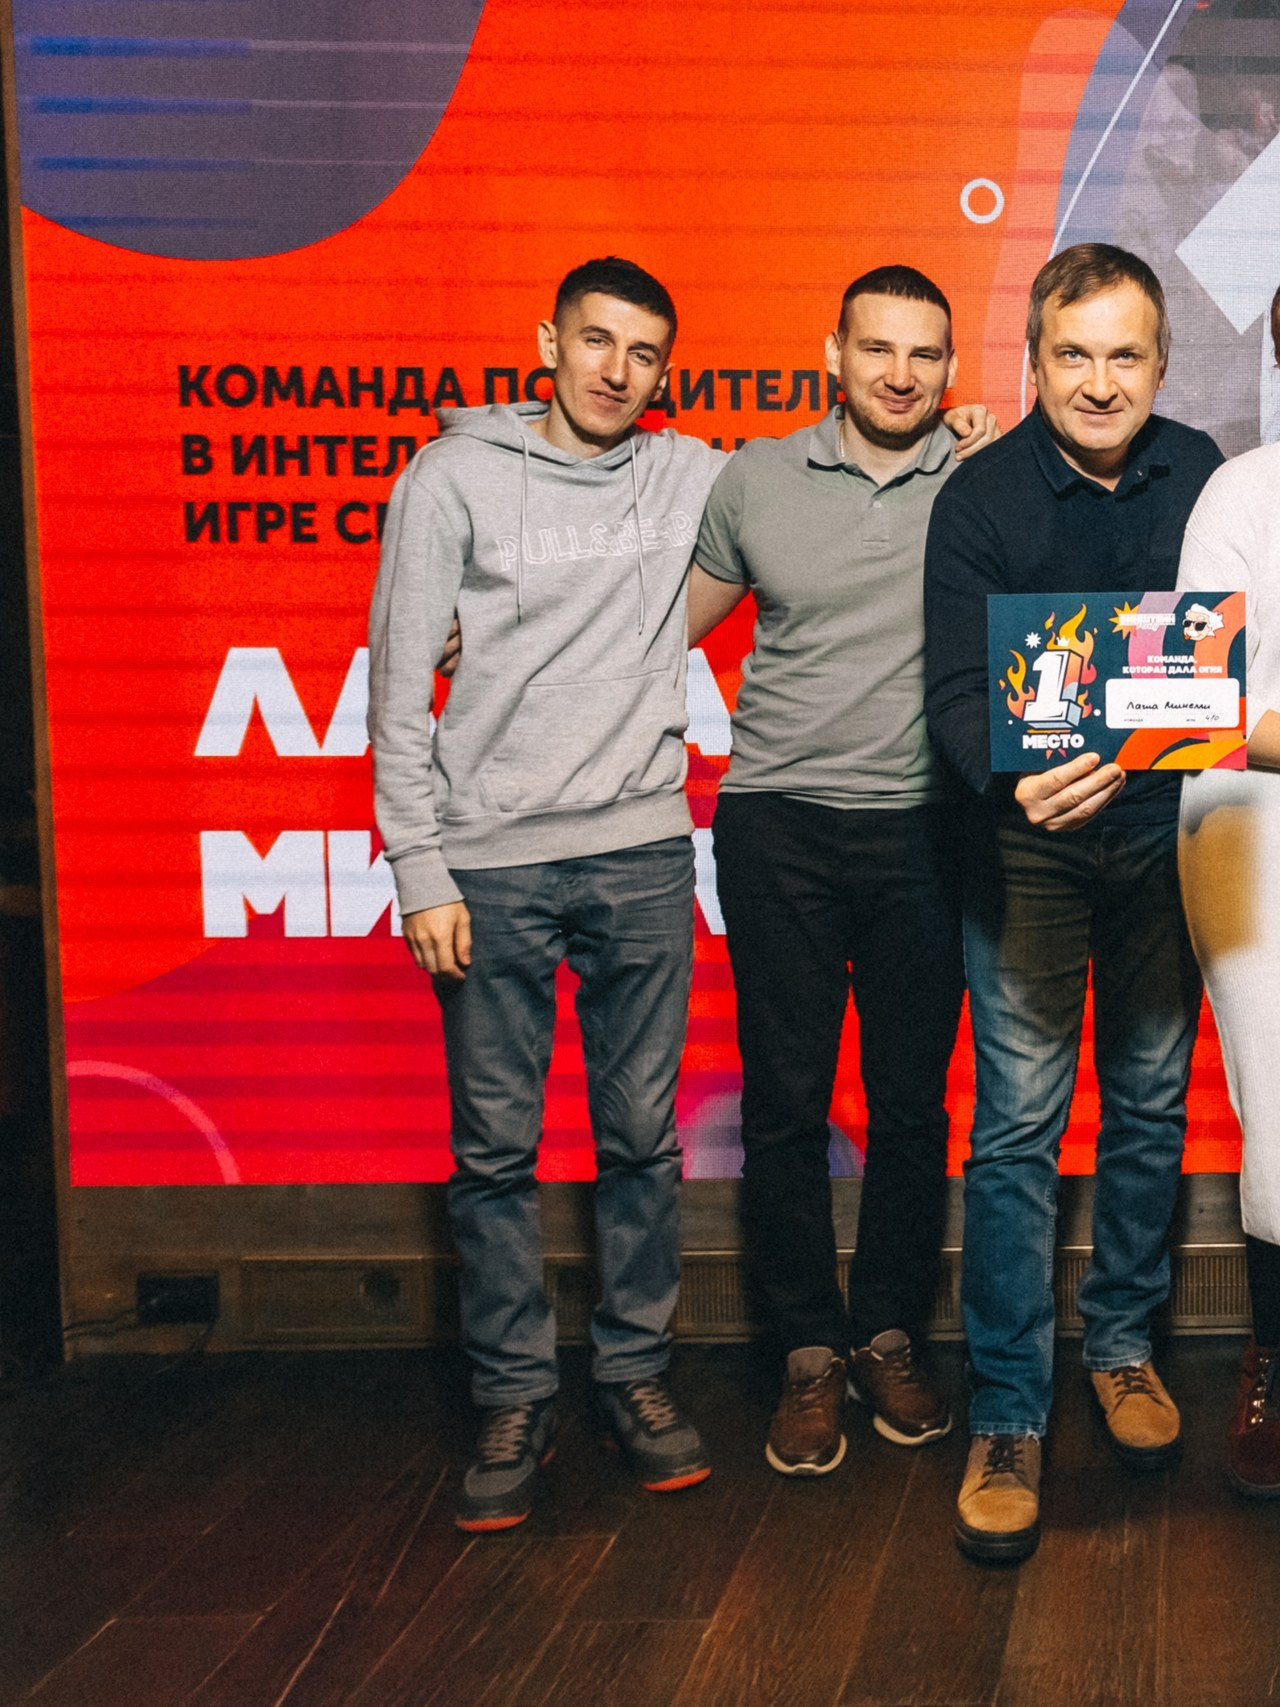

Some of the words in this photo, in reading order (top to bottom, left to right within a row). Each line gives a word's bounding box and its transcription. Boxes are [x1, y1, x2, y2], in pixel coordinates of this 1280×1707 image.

[179, 364, 467, 416] КОМАНДА
[484, 367, 845, 417] ПОДИТЕЛ
[181, 434, 213, 475] В
[184, 501, 317, 543] ИГРЕ
[1022, 649, 1084, 729] 1
[1122, 666, 1167, 675] КОТОРАЯ
[1168, 666, 1197, 675] ДАЛА
[1198, 665, 1223, 674] ОГНЯ
[1022, 733, 1085, 750] МЕСТО
